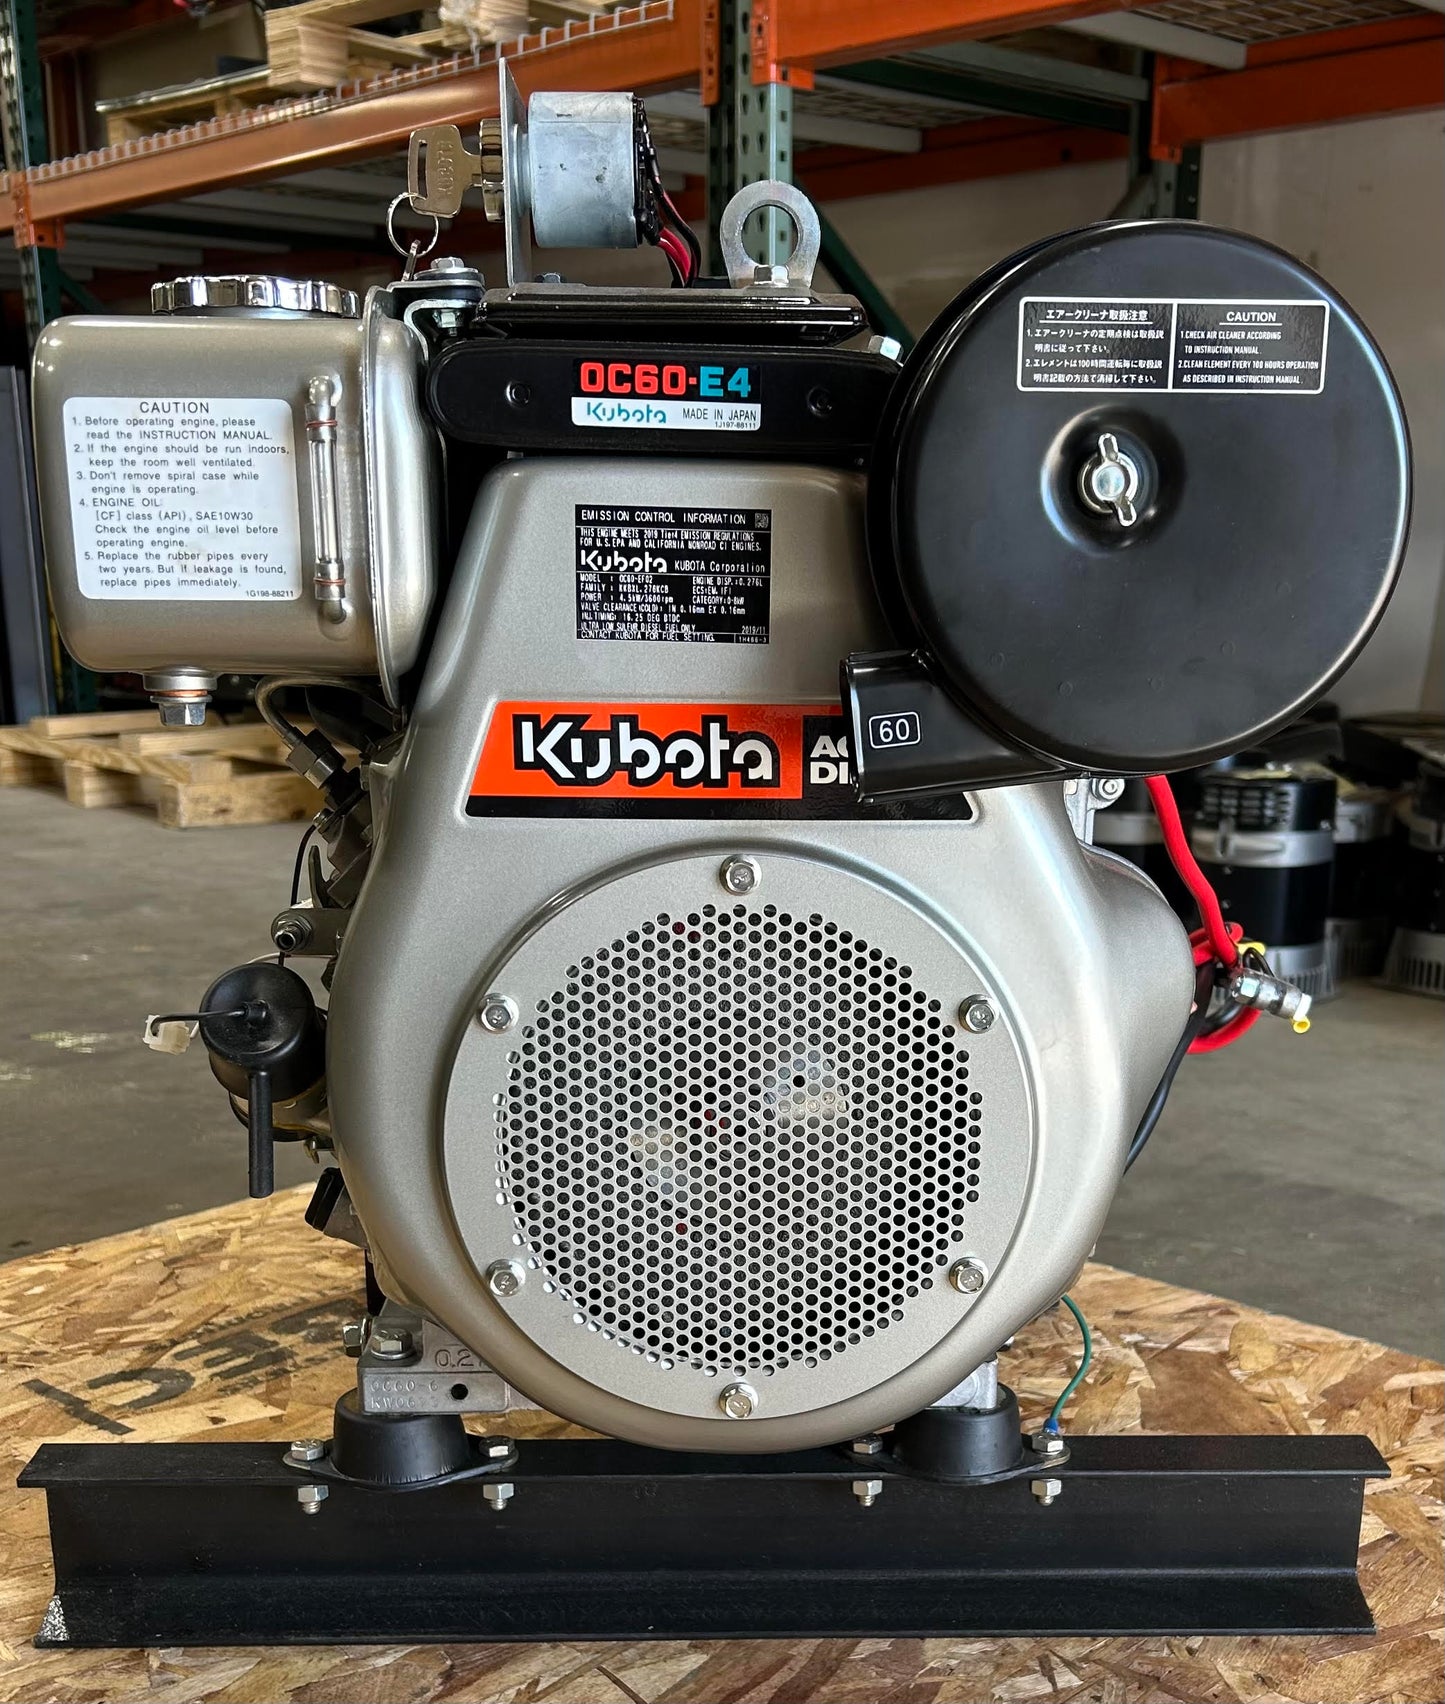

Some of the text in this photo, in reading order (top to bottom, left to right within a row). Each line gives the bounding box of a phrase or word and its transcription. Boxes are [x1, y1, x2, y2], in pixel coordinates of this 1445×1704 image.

[1226, 311, 1277, 322] CAUTION
[1206, 330, 1217, 340] AIR
[1219, 331, 1246, 340] CLEANER
[1247, 331, 1282, 341] ACCORDING
[1185, 345, 1194, 354] TO
[1194, 345, 1233, 354] INSTRUCTION
[1204, 360, 1231, 369] ELEMENT
[1232, 360, 1251, 369] EVERY
[1253, 361, 1263, 369] 100
[1264, 361, 1285, 370] HOURS
[1286, 361, 1319, 370] OPERATION
[1183, 374, 1191, 383] AS
[1192, 375, 1226, 384] DESCRIBED
[1227, 375, 1234, 384] IN
[1235, 375, 1274, 384] INSTRUCTION
[139, 402, 209, 414] CAUTION
[587, 402, 757, 424] Kubota MADE IN JAPAN
[72, 416, 82, 426] 1.
[85, 416, 119, 426] Before
[126, 416, 174, 428] operating
[222, 418, 256, 427] please
[87, 430, 272, 440] read the INSTRUCTION MANUAL.
[73, 444, 84, 453] 2.
[87, 444, 95, 453] If
[101, 444, 117, 453] the
[124, 445, 158, 455] engine
[165, 444, 199, 453] should
[206, 445, 218, 453] be
[249, 445, 290, 455] indoors,
[89, 458, 114, 467] keep
[121, 458, 137, 467] the
[144, 459, 169, 467] room
[176, 458, 196, 467] well
[76, 471, 86, 480] 3.
[90, 471, 117, 480] Don't
[123, 472, 161, 480] remove
[167, 472, 196, 482] spiral
[233, 472, 259, 481] while
[92, 485, 126, 496] engine
[133, 485, 141, 494] is
[79, 498, 89, 507] 4.
[92, 498, 135, 507] ENGINE
[96, 510, 121, 521] [CF]
[126, 511, 153, 520] class
[196, 511, 253, 521] SAE10W30
[581, 509, 746, 525] EMISSION CONTROL INFORMATION
[95, 524, 279, 536] Check the engine oil level before
[580, 527, 594, 537] THIS
[597, 528, 618, 538] ENGINE
[620, 529, 639, 538] MEETS
[661, 530, 678, 539] Tier4
[681, 530, 711, 540] EMISSION
[713, 532, 754, 541] REGULATIONS
[96, 539, 188, 549] operating engine.
[580, 537, 593, 547] FOR
[629, 539, 641, 549] AND
[644, 539, 685, 550] CALIFORNIA
[688, 541, 717, 550] NONROAD
[720, 541, 727, 550] CI
[731, 541, 761, 551] ENGINES.
[84, 551, 268, 563] 5. Replace the rubber pipes every
[581, 549, 765, 573] Kubota KUBOTA Corporation
[99, 565, 117, 574] two
[157, 565, 174, 574] But
[181, 565, 187, 574] if
[194, 565, 233, 575] leakage
[240, 565, 248, 574] is
[255, 565, 287, 575] found,
[101, 578, 137, 588] replace
[144, 578, 171, 588] pipes
[580, 573, 601, 583] MODEL
[692, 576, 714, 585] ENGINE
[580, 583, 605, 592] FAMILY
[580, 592, 602, 602] POWER
[581, 602, 600, 611] VALVE
[668, 604, 677, 613] IN
[708, 605, 717, 614] EX
[623, 613, 643, 622] 16.25
[647, 613, 660, 622] DEG
[663, 613, 680, 623] BTDC
[580, 621, 599, 631] ULTRA
[602, 622, 614, 631] LOW
[640, 623, 661, 632] DIESEL
[665, 623, 679, 633] FUEL
[680, 624, 695, 633] ONLY
[581, 630, 612, 639] CONTACT
[615, 631, 642, 640] KUBOTA
[645, 631, 659, 640] FOR
[662, 632, 679, 641] FUEL
[878, 718, 909, 743] 60
[522, 721, 772, 780] Kubota
